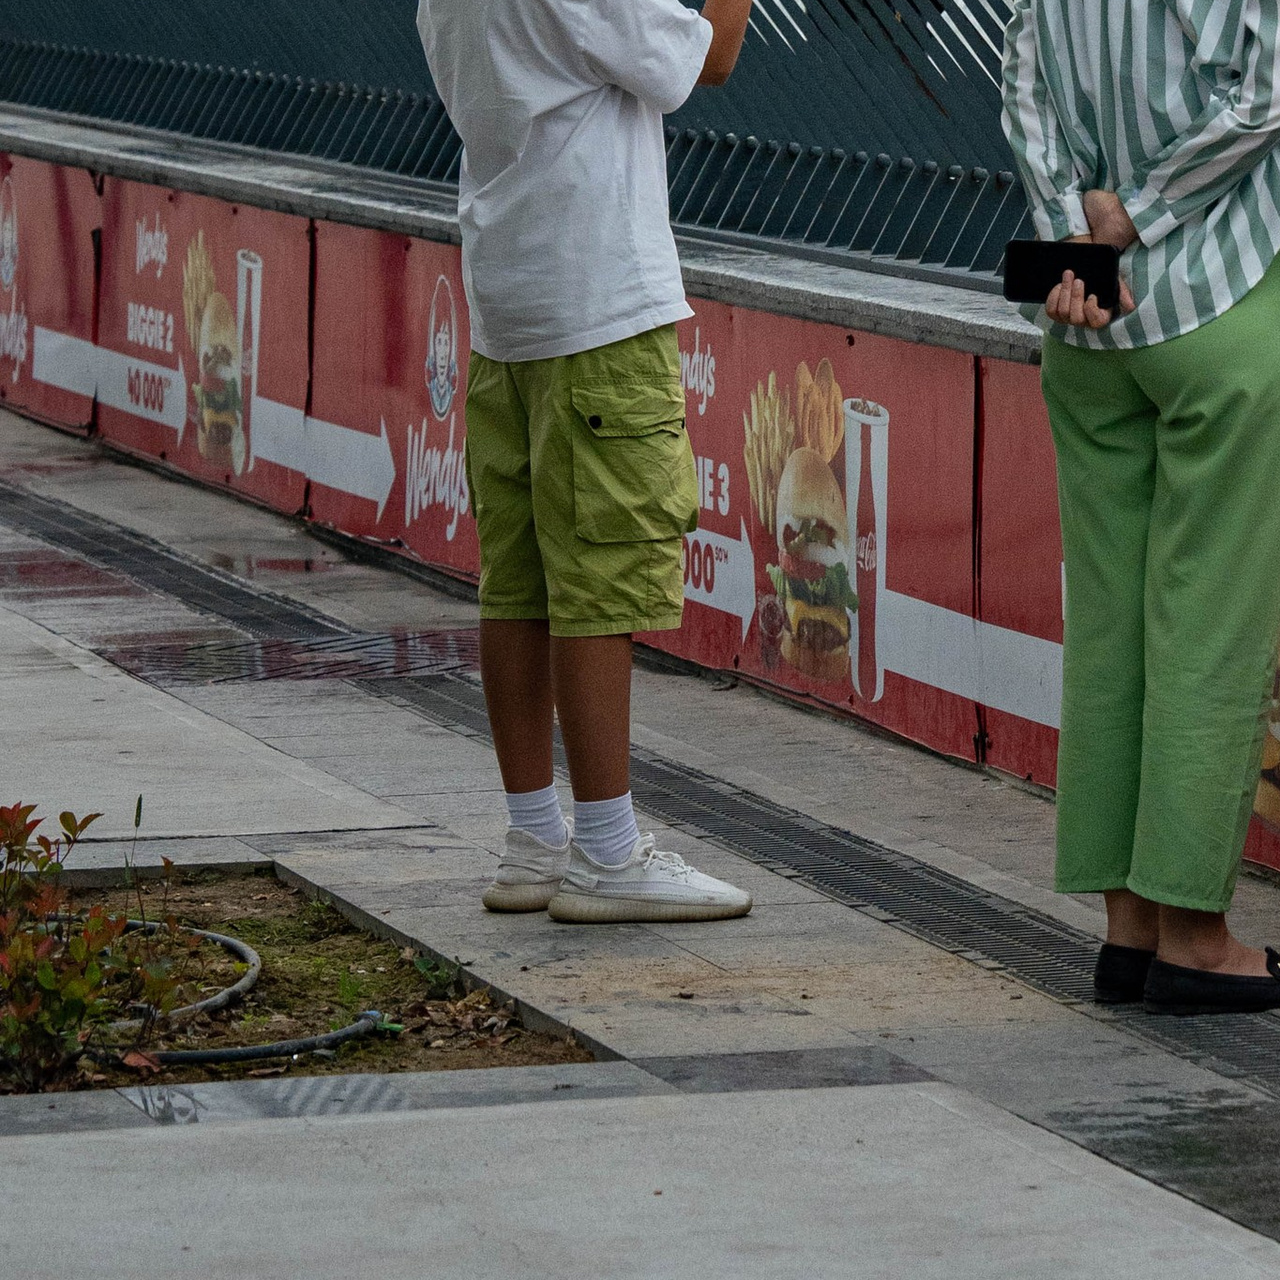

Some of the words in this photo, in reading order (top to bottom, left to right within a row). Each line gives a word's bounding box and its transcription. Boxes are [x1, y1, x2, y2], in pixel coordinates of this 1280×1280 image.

[0, 281, 27, 385] ndy's
[127, 302, 165, 351] BIGGIE
[166, 311, 174, 354] 2
[679, 326, 716, 416] ndy's
[717, 462, 730, 516] 3
